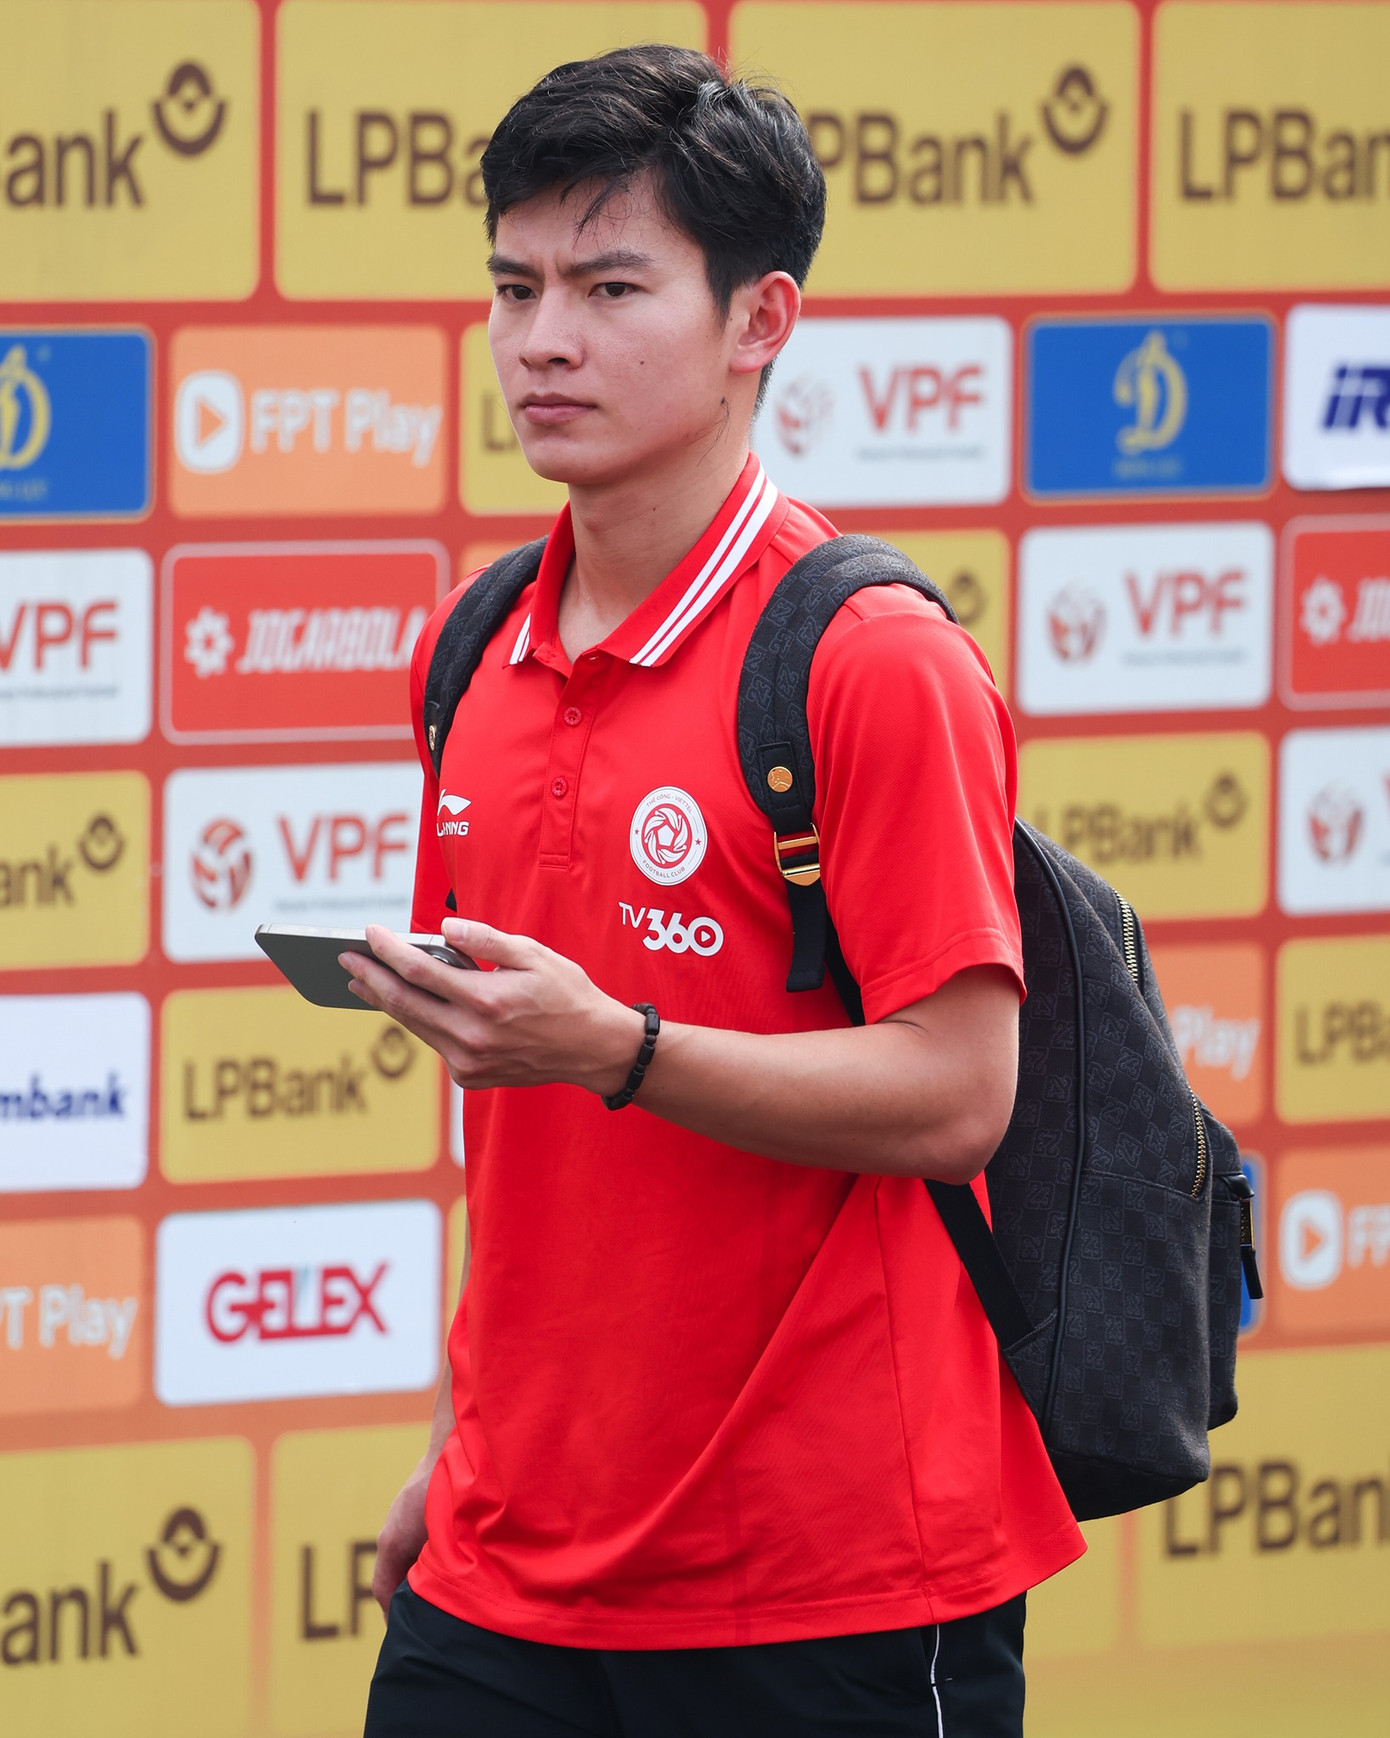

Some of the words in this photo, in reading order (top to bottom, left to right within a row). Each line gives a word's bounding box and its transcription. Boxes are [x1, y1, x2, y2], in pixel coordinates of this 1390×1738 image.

[3, 108, 146, 210] ank
[807, 109, 1035, 208] PBank
[250, 388, 339, 453] FPT
[344, 386, 443, 468] Play
[859, 363, 985, 433] VPF
[1125, 568, 1246, 637] VPF
[277, 811, 411, 884] VPF
[1295, 1001, 1390, 1066] LPB
[184, 1054, 369, 1122] LPBank
[39, 1284, 138, 1359] Play
[206, 1262, 389, 1344] GELEX
[1164, 1458, 1390, 1558] LPBan
